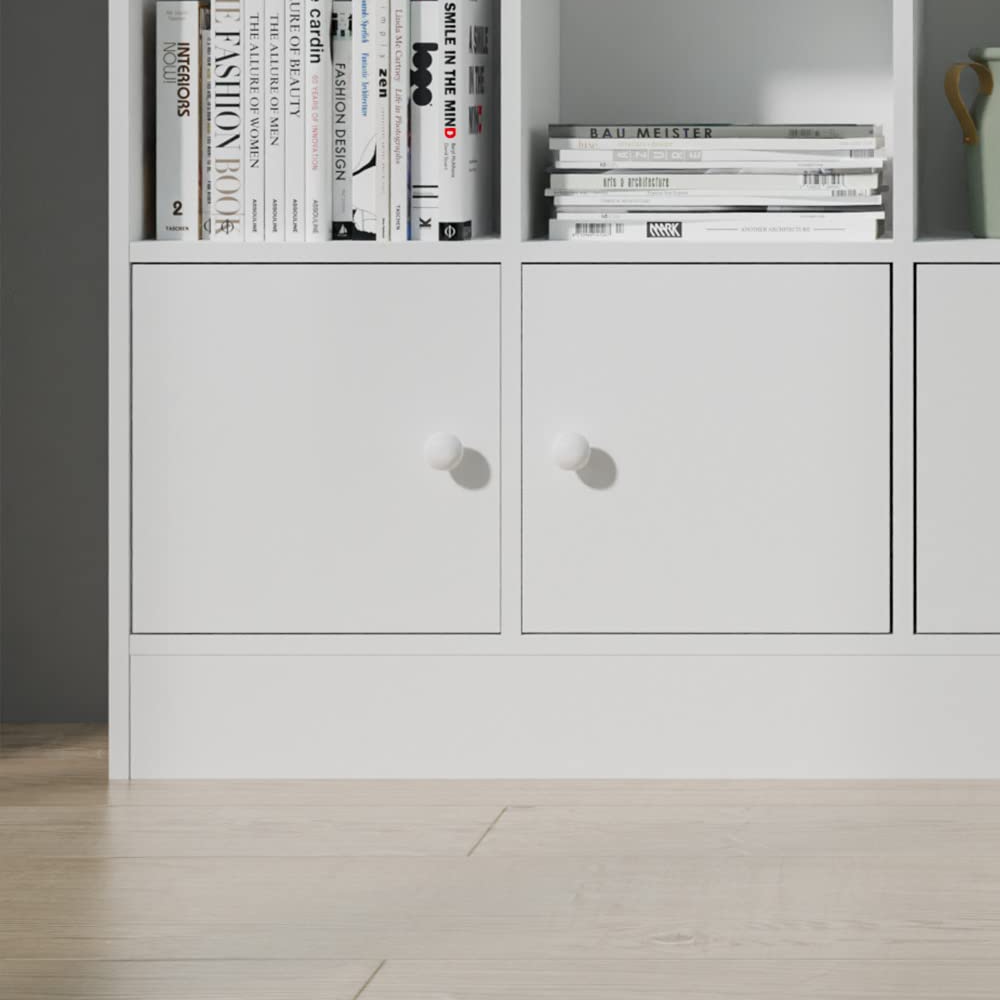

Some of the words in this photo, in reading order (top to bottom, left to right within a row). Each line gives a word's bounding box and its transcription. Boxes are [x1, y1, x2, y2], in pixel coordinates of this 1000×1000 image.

[249, 13, 259, 40] THE
[269, 13, 279, 40] THE
[310, 8, 324, 64] cardin
[394, 9, 403, 34] Linda
[444, 2, 456, 46] SMILE
[289, 36, 301, 56] OF
[394, 35, 403, 49] Mc
[162, 41, 177, 84] NOW!
[249, 43, 259, 94] ALLURE
[269, 43, 279, 94] ALLURE
[361, 52, 369, 79] Fantastic
[392, 50, 403, 82] Cartney
[444, 50, 456, 65] IN
[177, 42, 190, 117] INTERIORS
[214, 31, 241, 150] FASHION
[289, 59, 301, 118] BEAUTY
[335, 63, 346, 124] FASHION
[379, 68, 388, 98] zen
[444, 69, 456, 95] THE
[249, 96, 259, 115] OF
[269, 96, 279, 114] OF
[311, 87, 319, 110] YEARS
[361, 81, 369, 117] Architecture
[395, 89, 403, 104] Life
[395, 105, 403, 114] in
[269, 117, 279, 146] MEN
[311, 112, 319, 122] OF
[444, 100, 456, 139] MIND
[249, 117, 259, 169] WOMEN
[392, 115, 403, 164] Photographs
[590, 127, 626, 139] BAU
[637, 127, 713, 139] MEISTER
[311, 125, 319, 171] INNOVATION
[335, 129, 346, 181] DESIGN
[214, 158, 241, 235] BOOK
[603, 176, 617, 188] arts
[627, 176, 670, 188] architecture
[172, 200, 183, 216] 2
[649, 222, 681, 237] MARK
